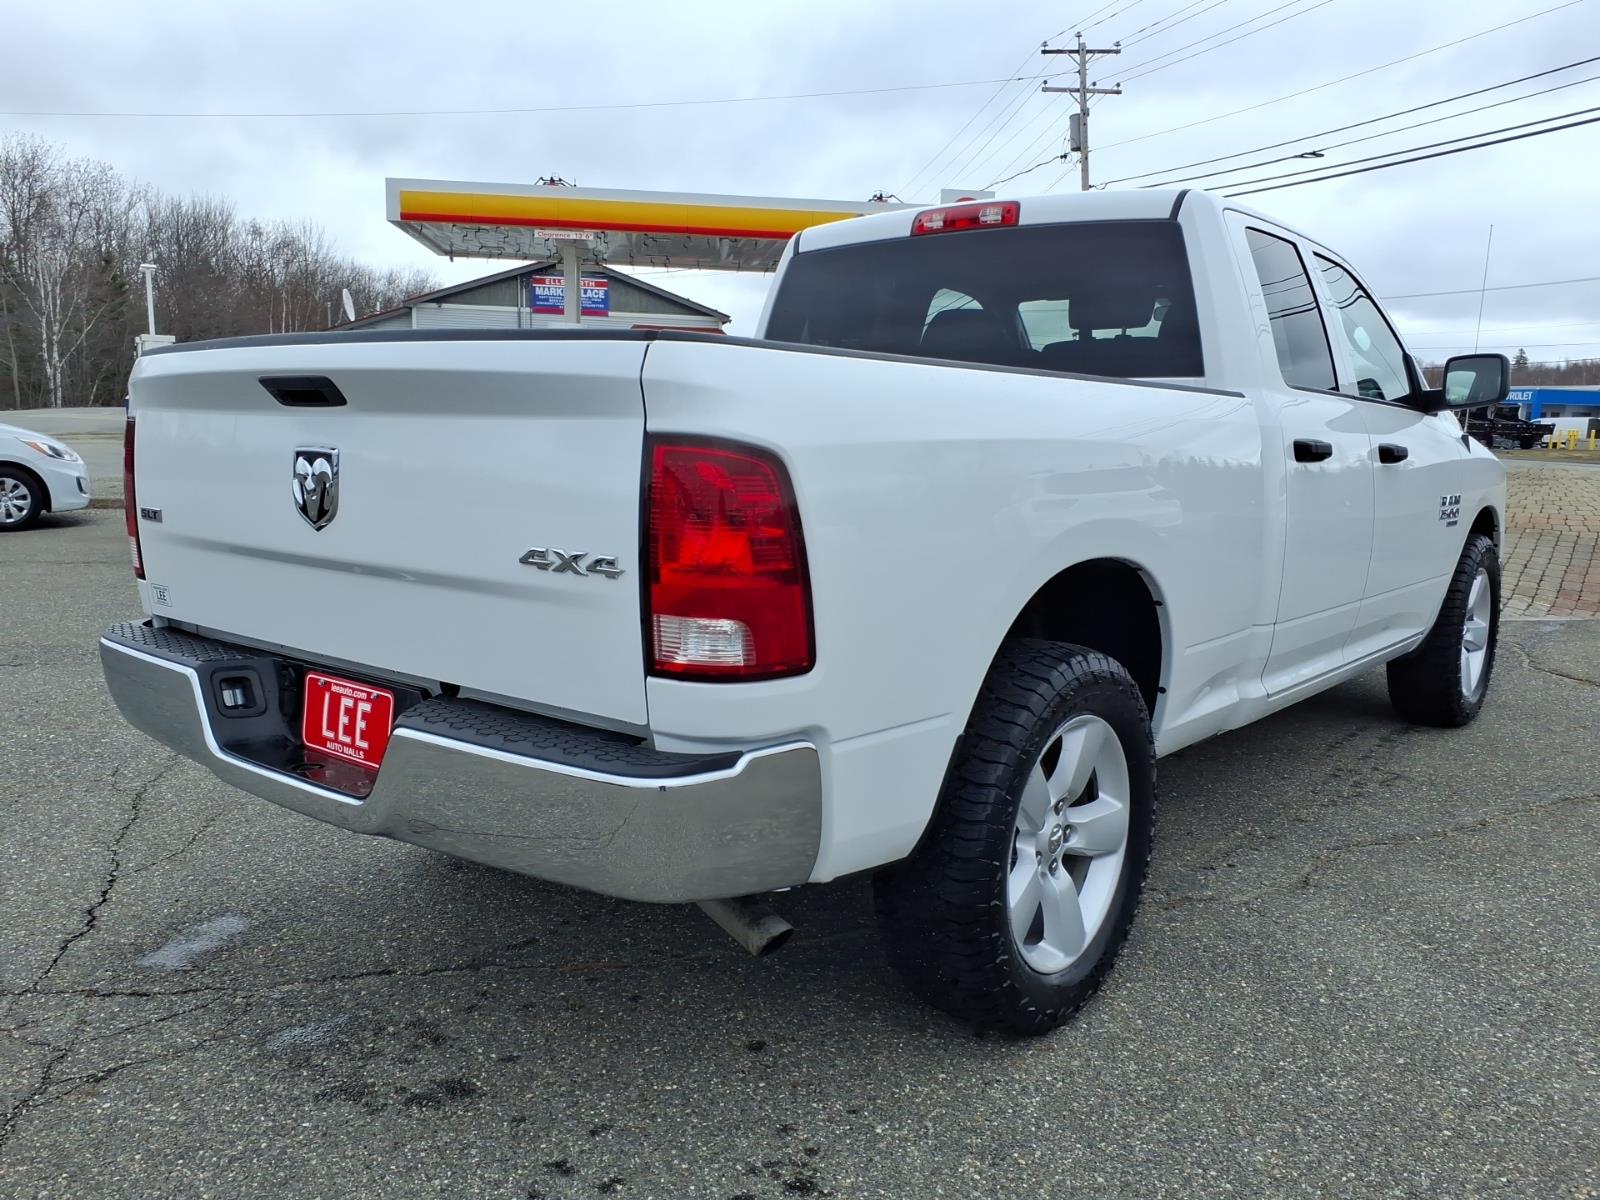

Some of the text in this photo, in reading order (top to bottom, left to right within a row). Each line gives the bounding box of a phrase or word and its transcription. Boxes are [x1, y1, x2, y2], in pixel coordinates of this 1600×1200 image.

[545, 278, 595, 287] ELLSRTH
[535, 287, 605, 299] MARKLACE
[141, 508, 159, 520] SLT
[156, 590, 168, 602] LEE
[331, 683, 368, 700] leeauto.com
[322, 691, 373, 751] LEE
[326, 740, 365, 760] AUTO MALLS
